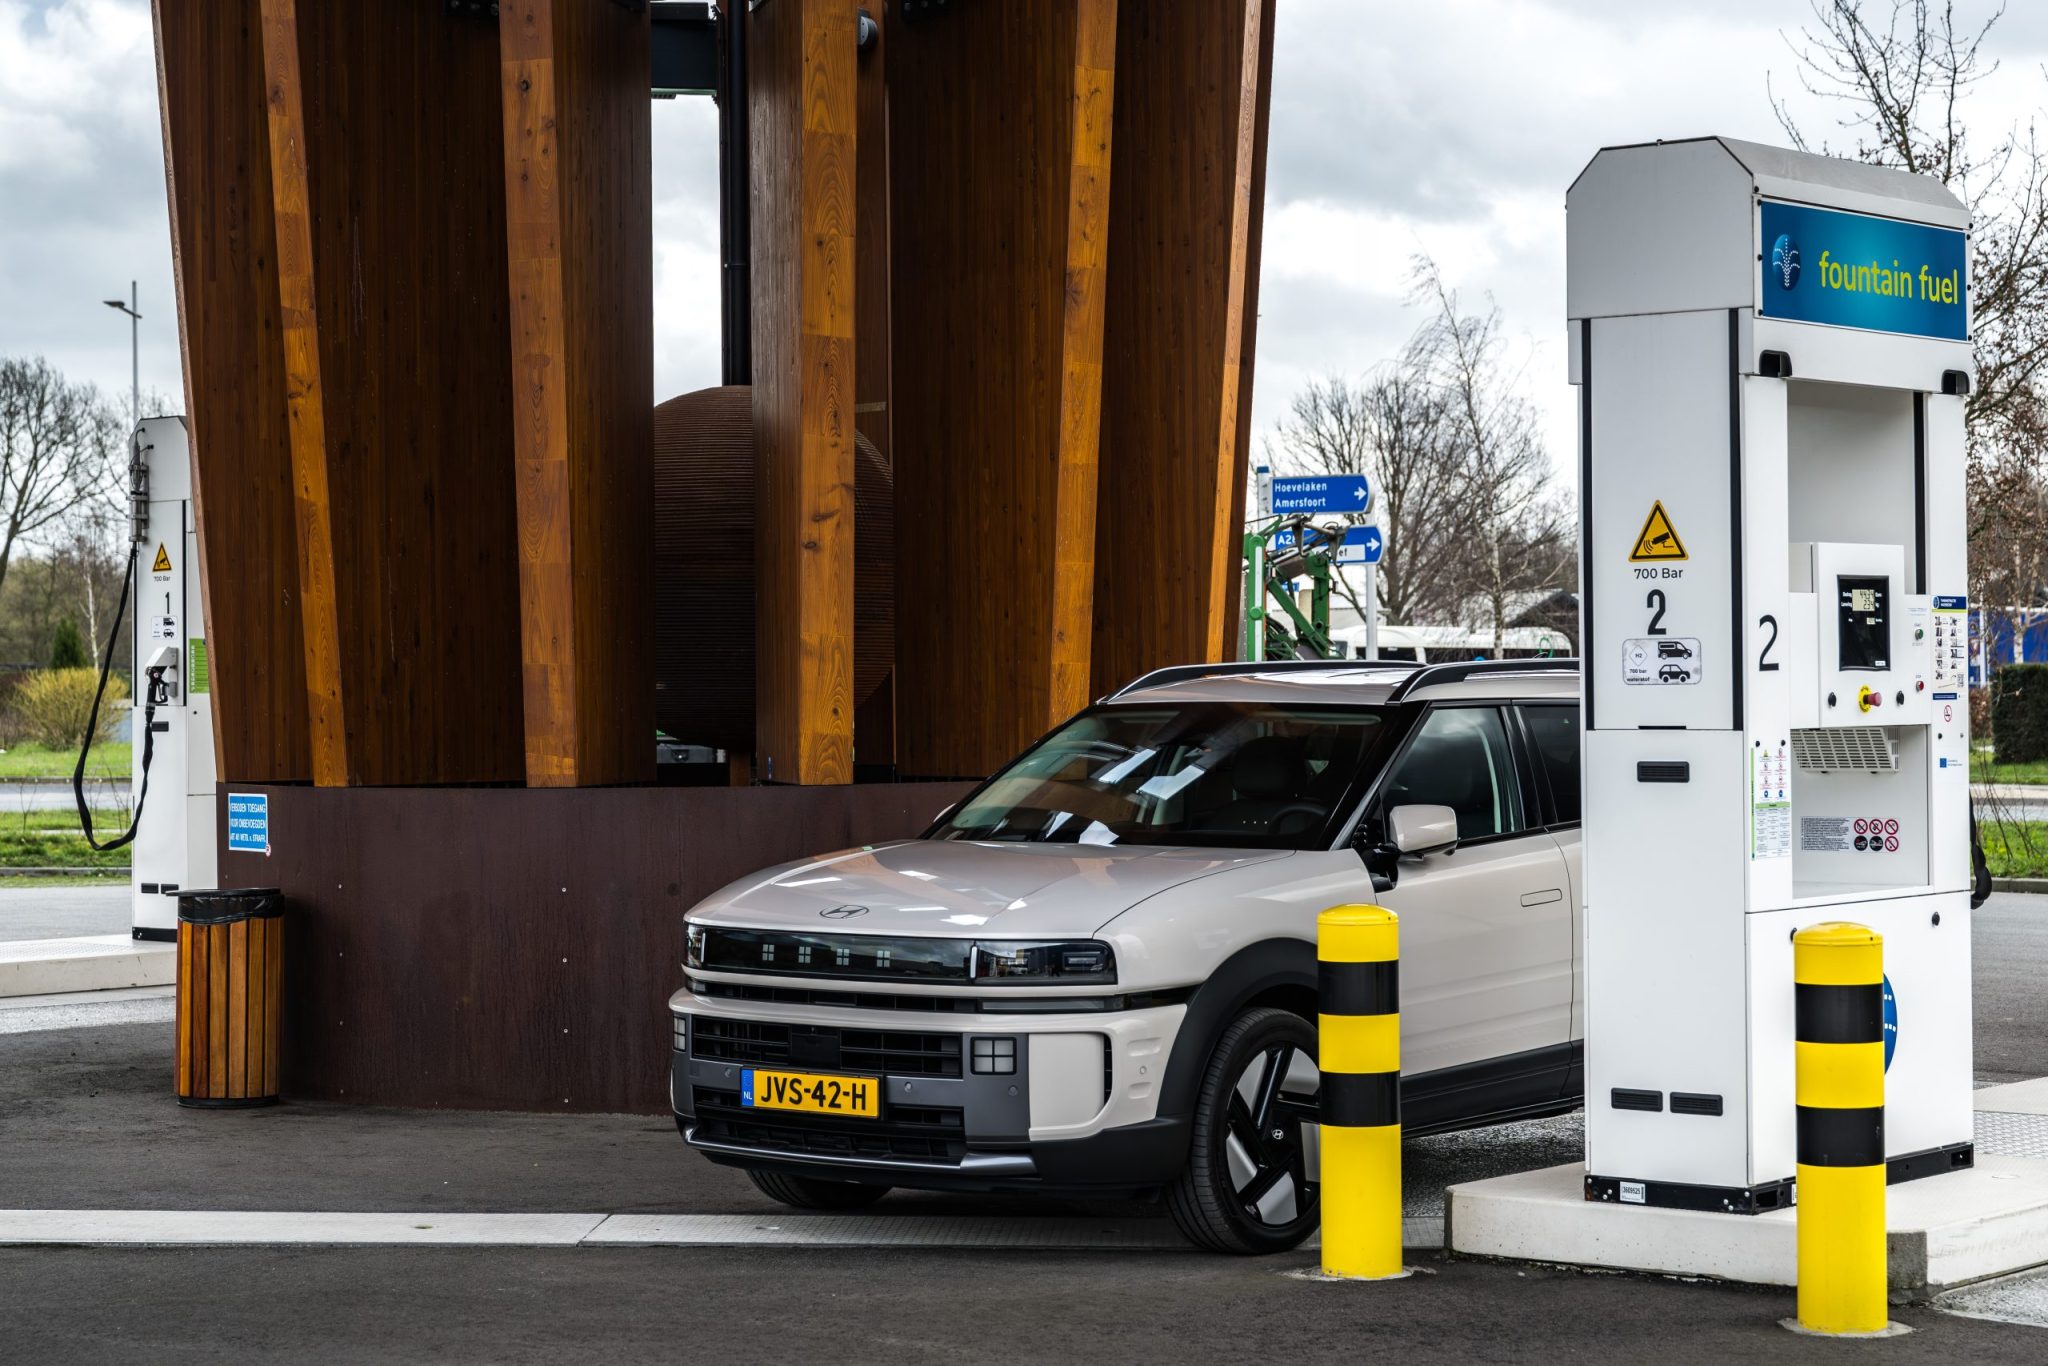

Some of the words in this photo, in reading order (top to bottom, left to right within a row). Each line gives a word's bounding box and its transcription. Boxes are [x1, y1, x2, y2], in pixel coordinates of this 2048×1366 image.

[1819, 250, 1912, 299] fountain
[1919, 264, 1958, 305] fuel
[1274, 482, 1327, 493] Hoevelaken
[1274, 497, 1326, 508] Amersfoort
[1634, 568, 1658, 580] 700
[1662, 567, 1684, 579] Bar
[165, 591, 170, 615] 1
[1646, 589, 1667, 636] 2
[1759, 614, 1780, 672] 2
[743, 1091, 753, 1100] NL
[761, 1075, 867, 1111] JVS-42-H
